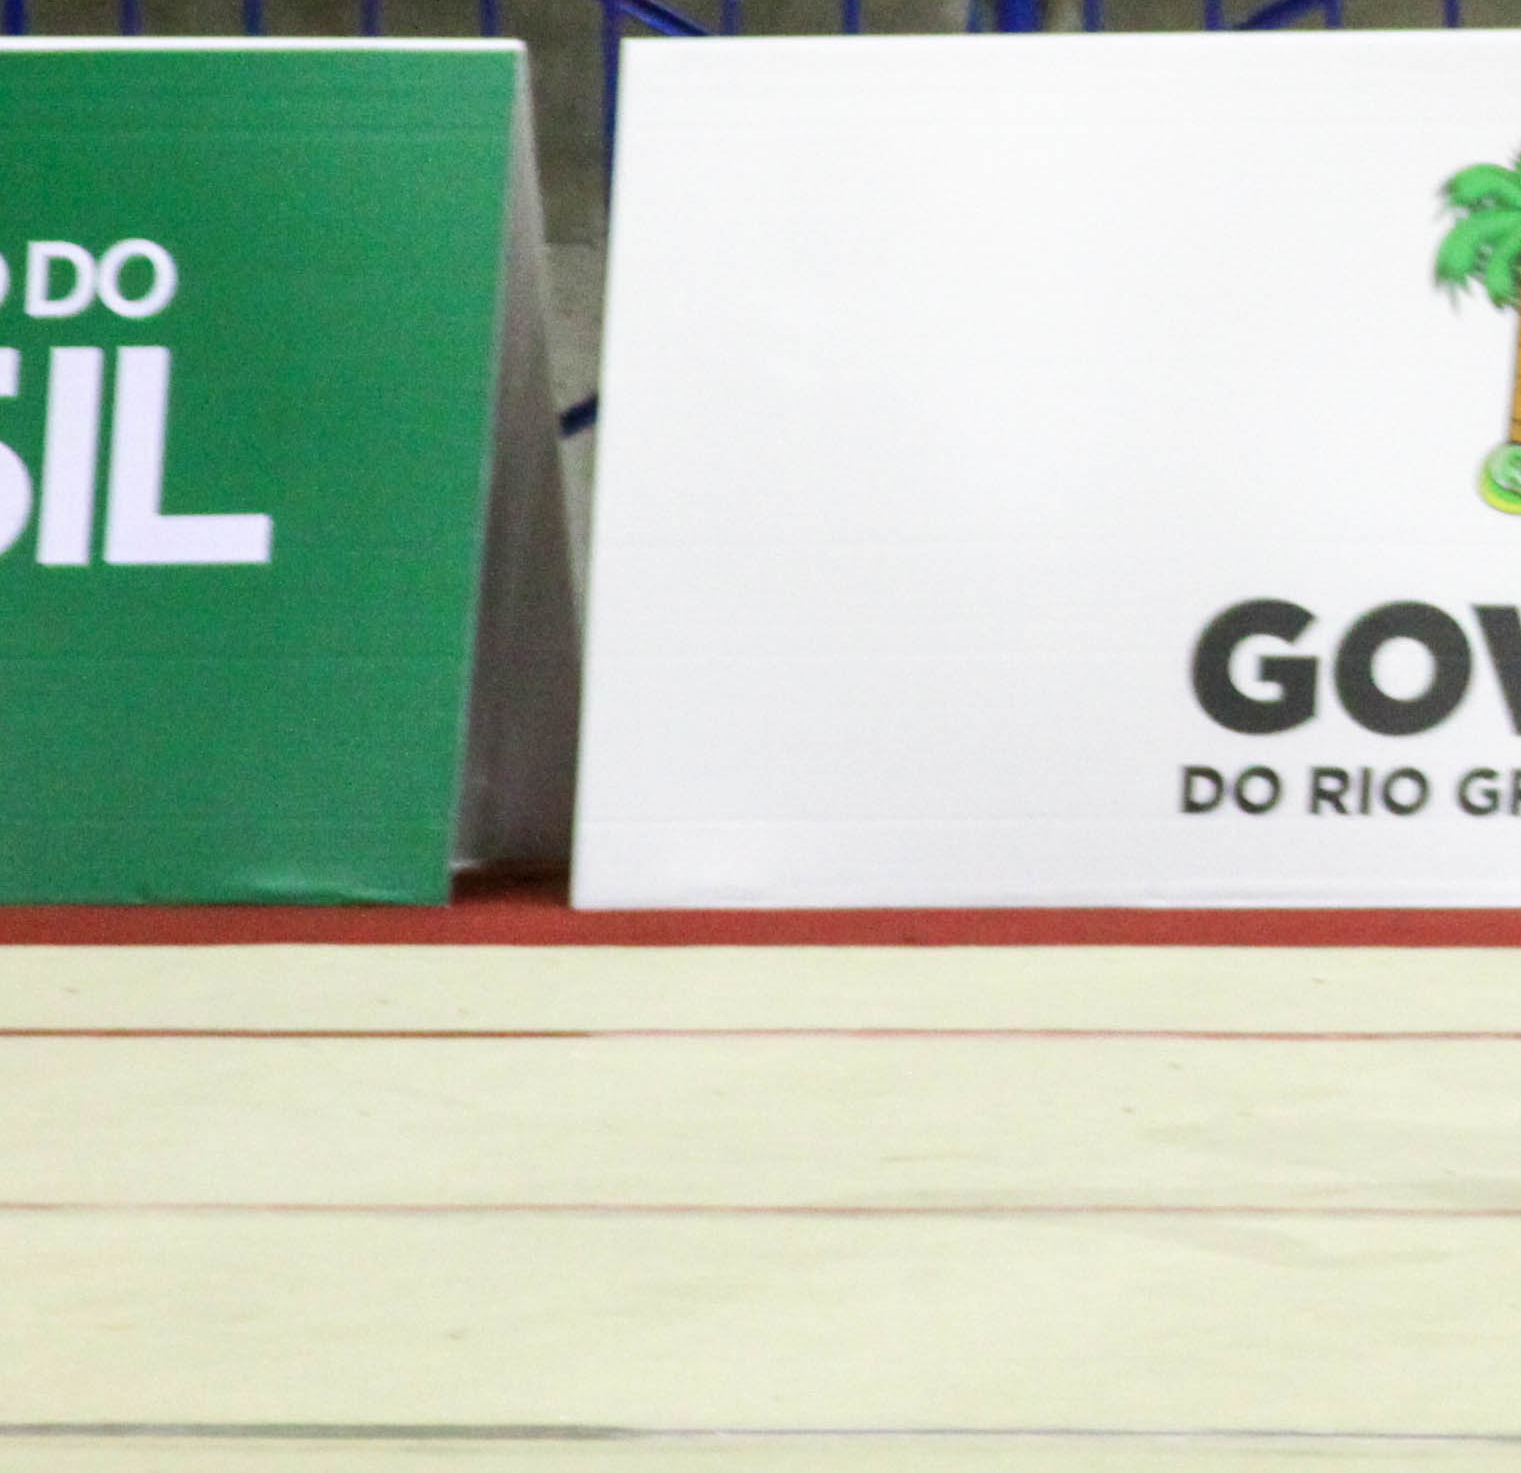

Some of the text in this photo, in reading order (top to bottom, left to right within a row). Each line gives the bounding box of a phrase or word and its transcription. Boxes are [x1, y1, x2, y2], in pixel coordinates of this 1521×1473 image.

[25, 239, 178, 318] DO
[0, 345, 273, 565] IL
[1181, 766, 1282, 815] DO
[1309, 767, 1430, 816] RIO
